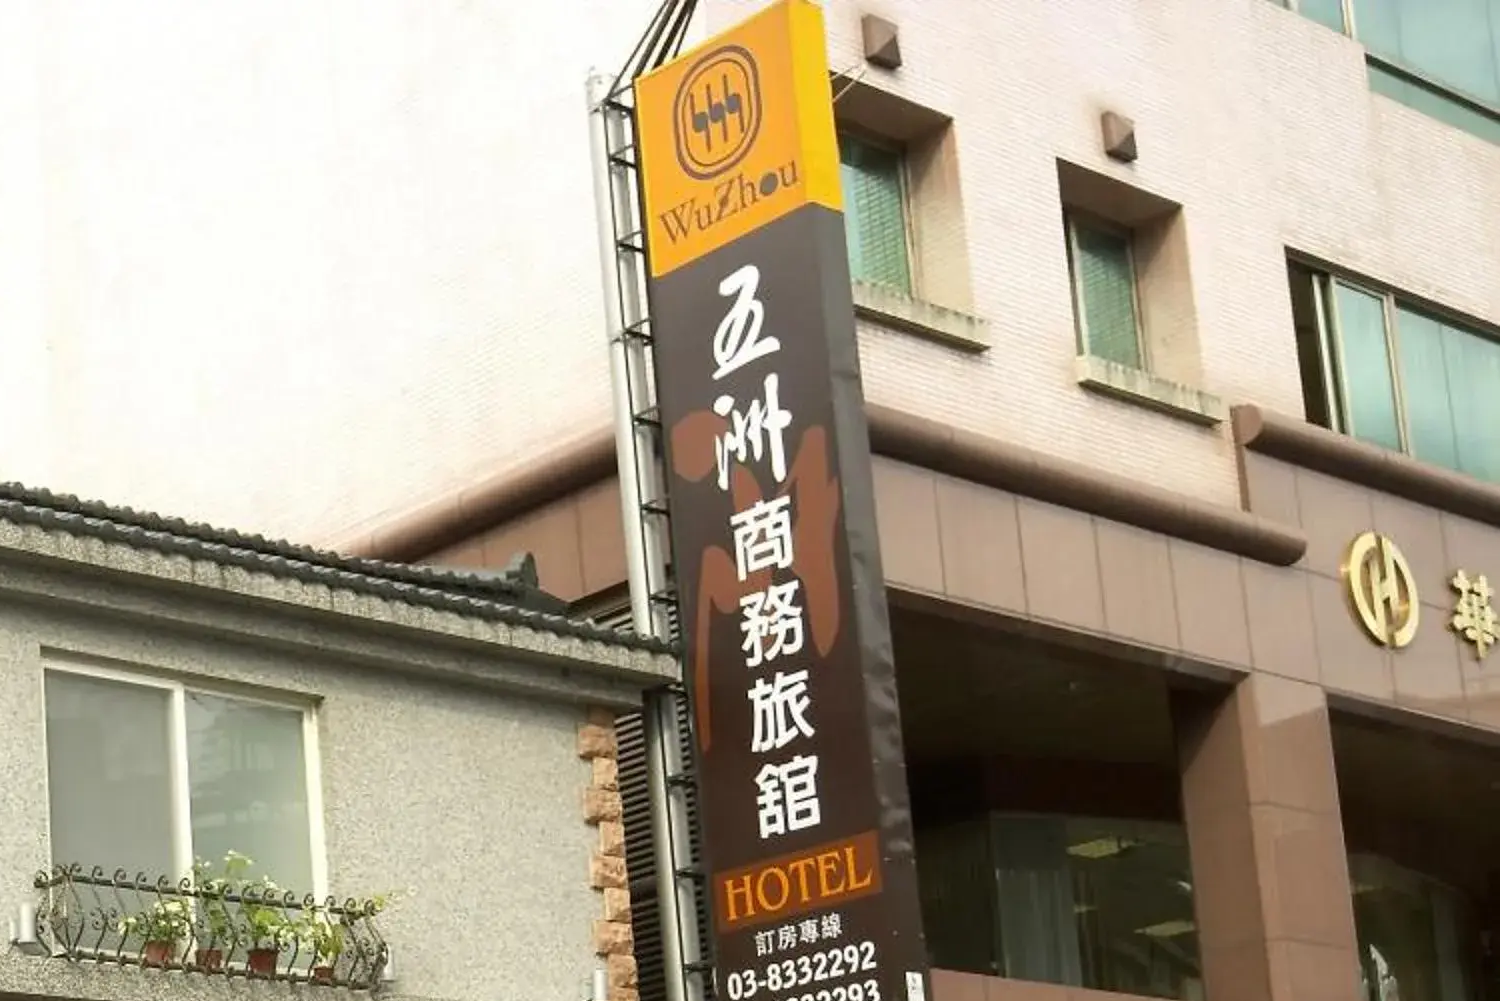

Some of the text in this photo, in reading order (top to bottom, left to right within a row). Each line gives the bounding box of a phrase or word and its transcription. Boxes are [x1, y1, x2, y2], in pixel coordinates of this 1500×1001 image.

[659, 158, 799, 246] WuZhou
[724, 846, 874, 921] HOTEL
[754, 912, 843, 957] 訂房專線
[728, 941, 877, 1001] 03-8332292
